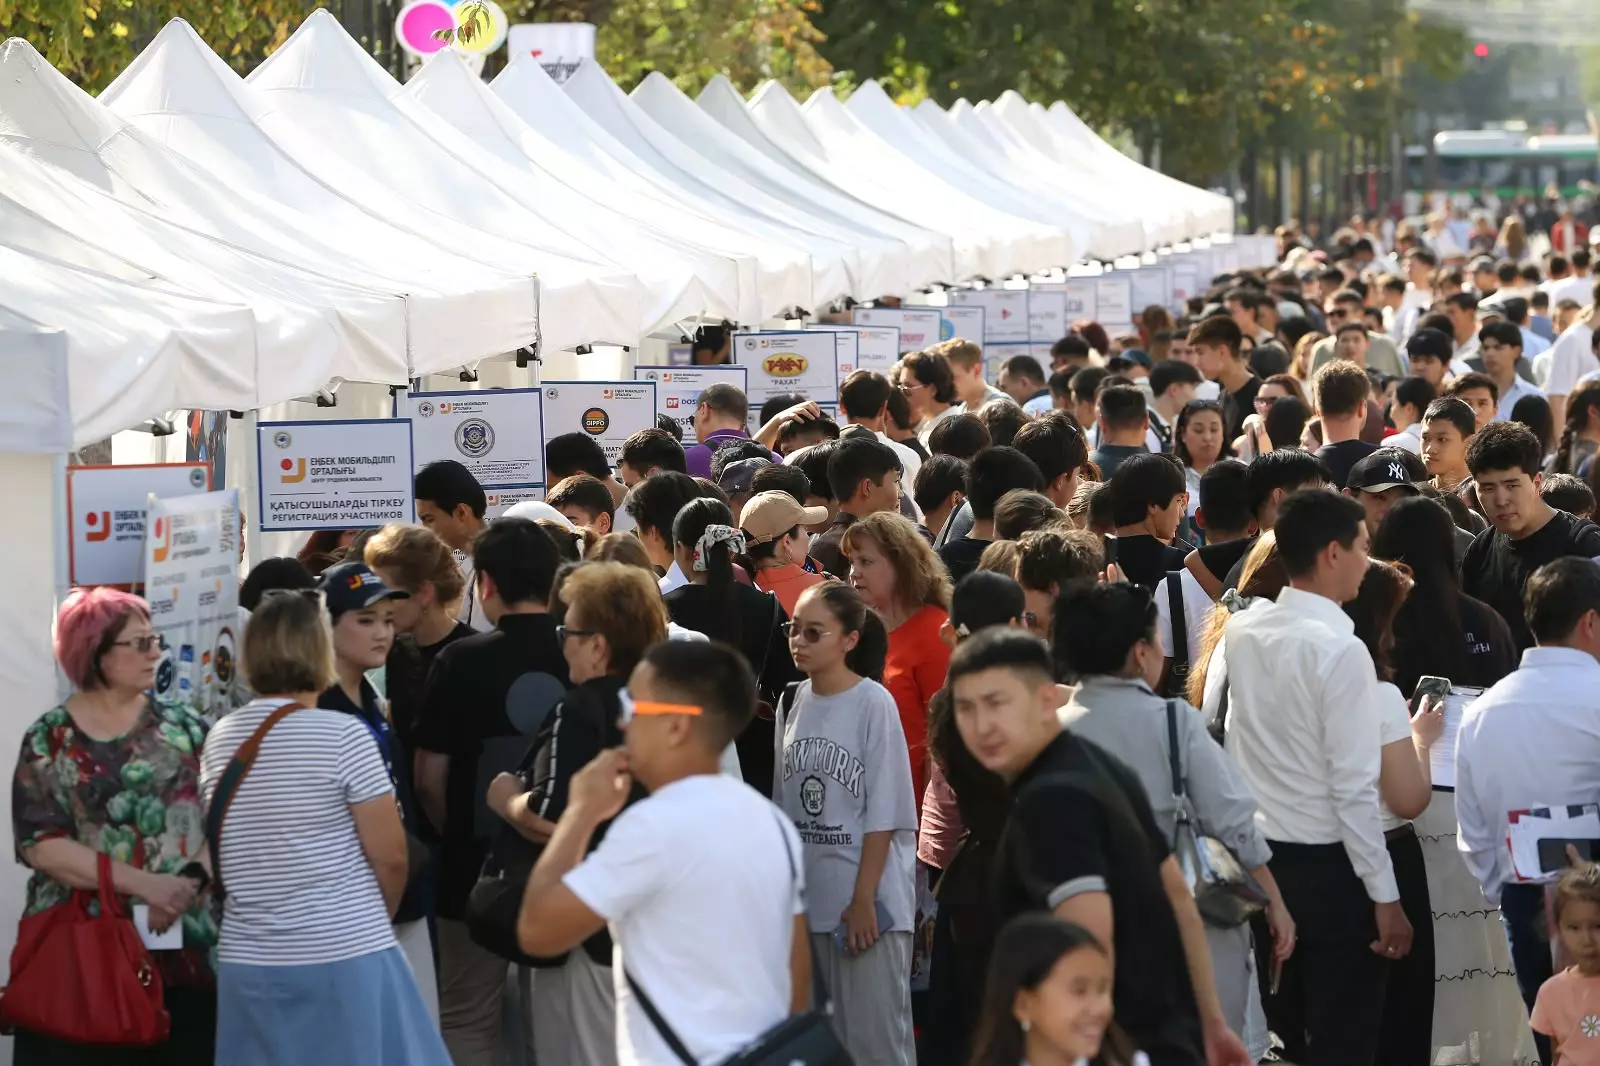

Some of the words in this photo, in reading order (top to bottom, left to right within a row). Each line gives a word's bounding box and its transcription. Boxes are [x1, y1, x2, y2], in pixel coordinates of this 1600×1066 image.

[310, 457, 336, 467] ЕҢБЕК
[338, 455, 395, 465] МОБИЛЬДІЛІГІ
[310, 467, 356, 476] ОРТАЛЫҒЫ
[1388, 462, 1404, 481] NY
[270, 499, 368, 512] ҚАТЫСУШЫЛАРДЫ
[371, 498, 405, 508] ТІРКЕУ
[272, 512, 338, 523] РЕГИСТРАЦИЯ
[340, 511, 403, 520] УЧАСТНИКОВ
[813, 737, 865, 798] YORK
